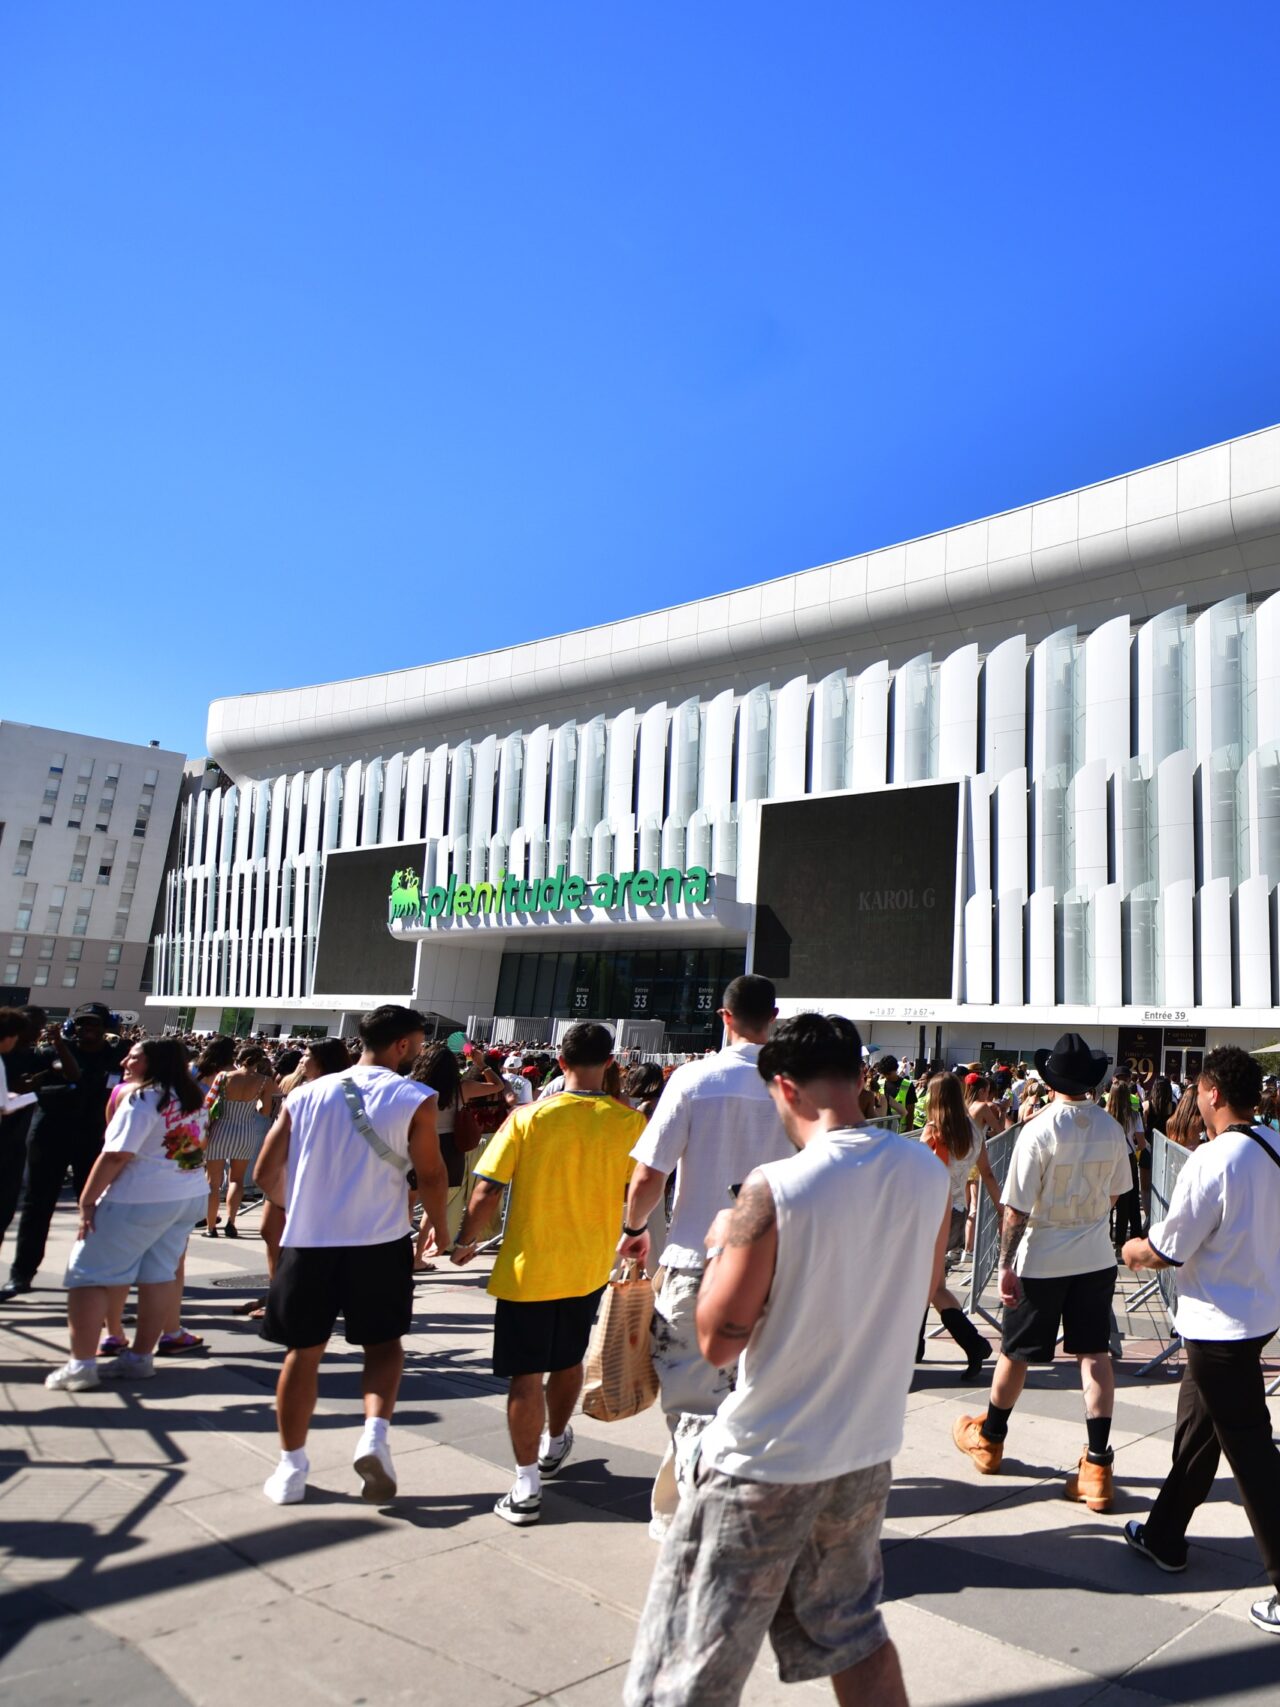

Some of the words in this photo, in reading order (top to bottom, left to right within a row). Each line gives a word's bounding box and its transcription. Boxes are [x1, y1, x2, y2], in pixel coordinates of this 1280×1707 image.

[424, 865, 586, 927] plenitude
[593, 866, 707, 909] arena
[859, 888, 919, 911] KAROL
[923, 887, 936, 909] G
[575, 995, 588, 1007] 33
[634, 995, 648, 1008] 33
[697, 995, 712, 1009] 33
[1144, 1011, 1172, 1020] Entrée
[1175, 1011, 1186, 1020] 39
